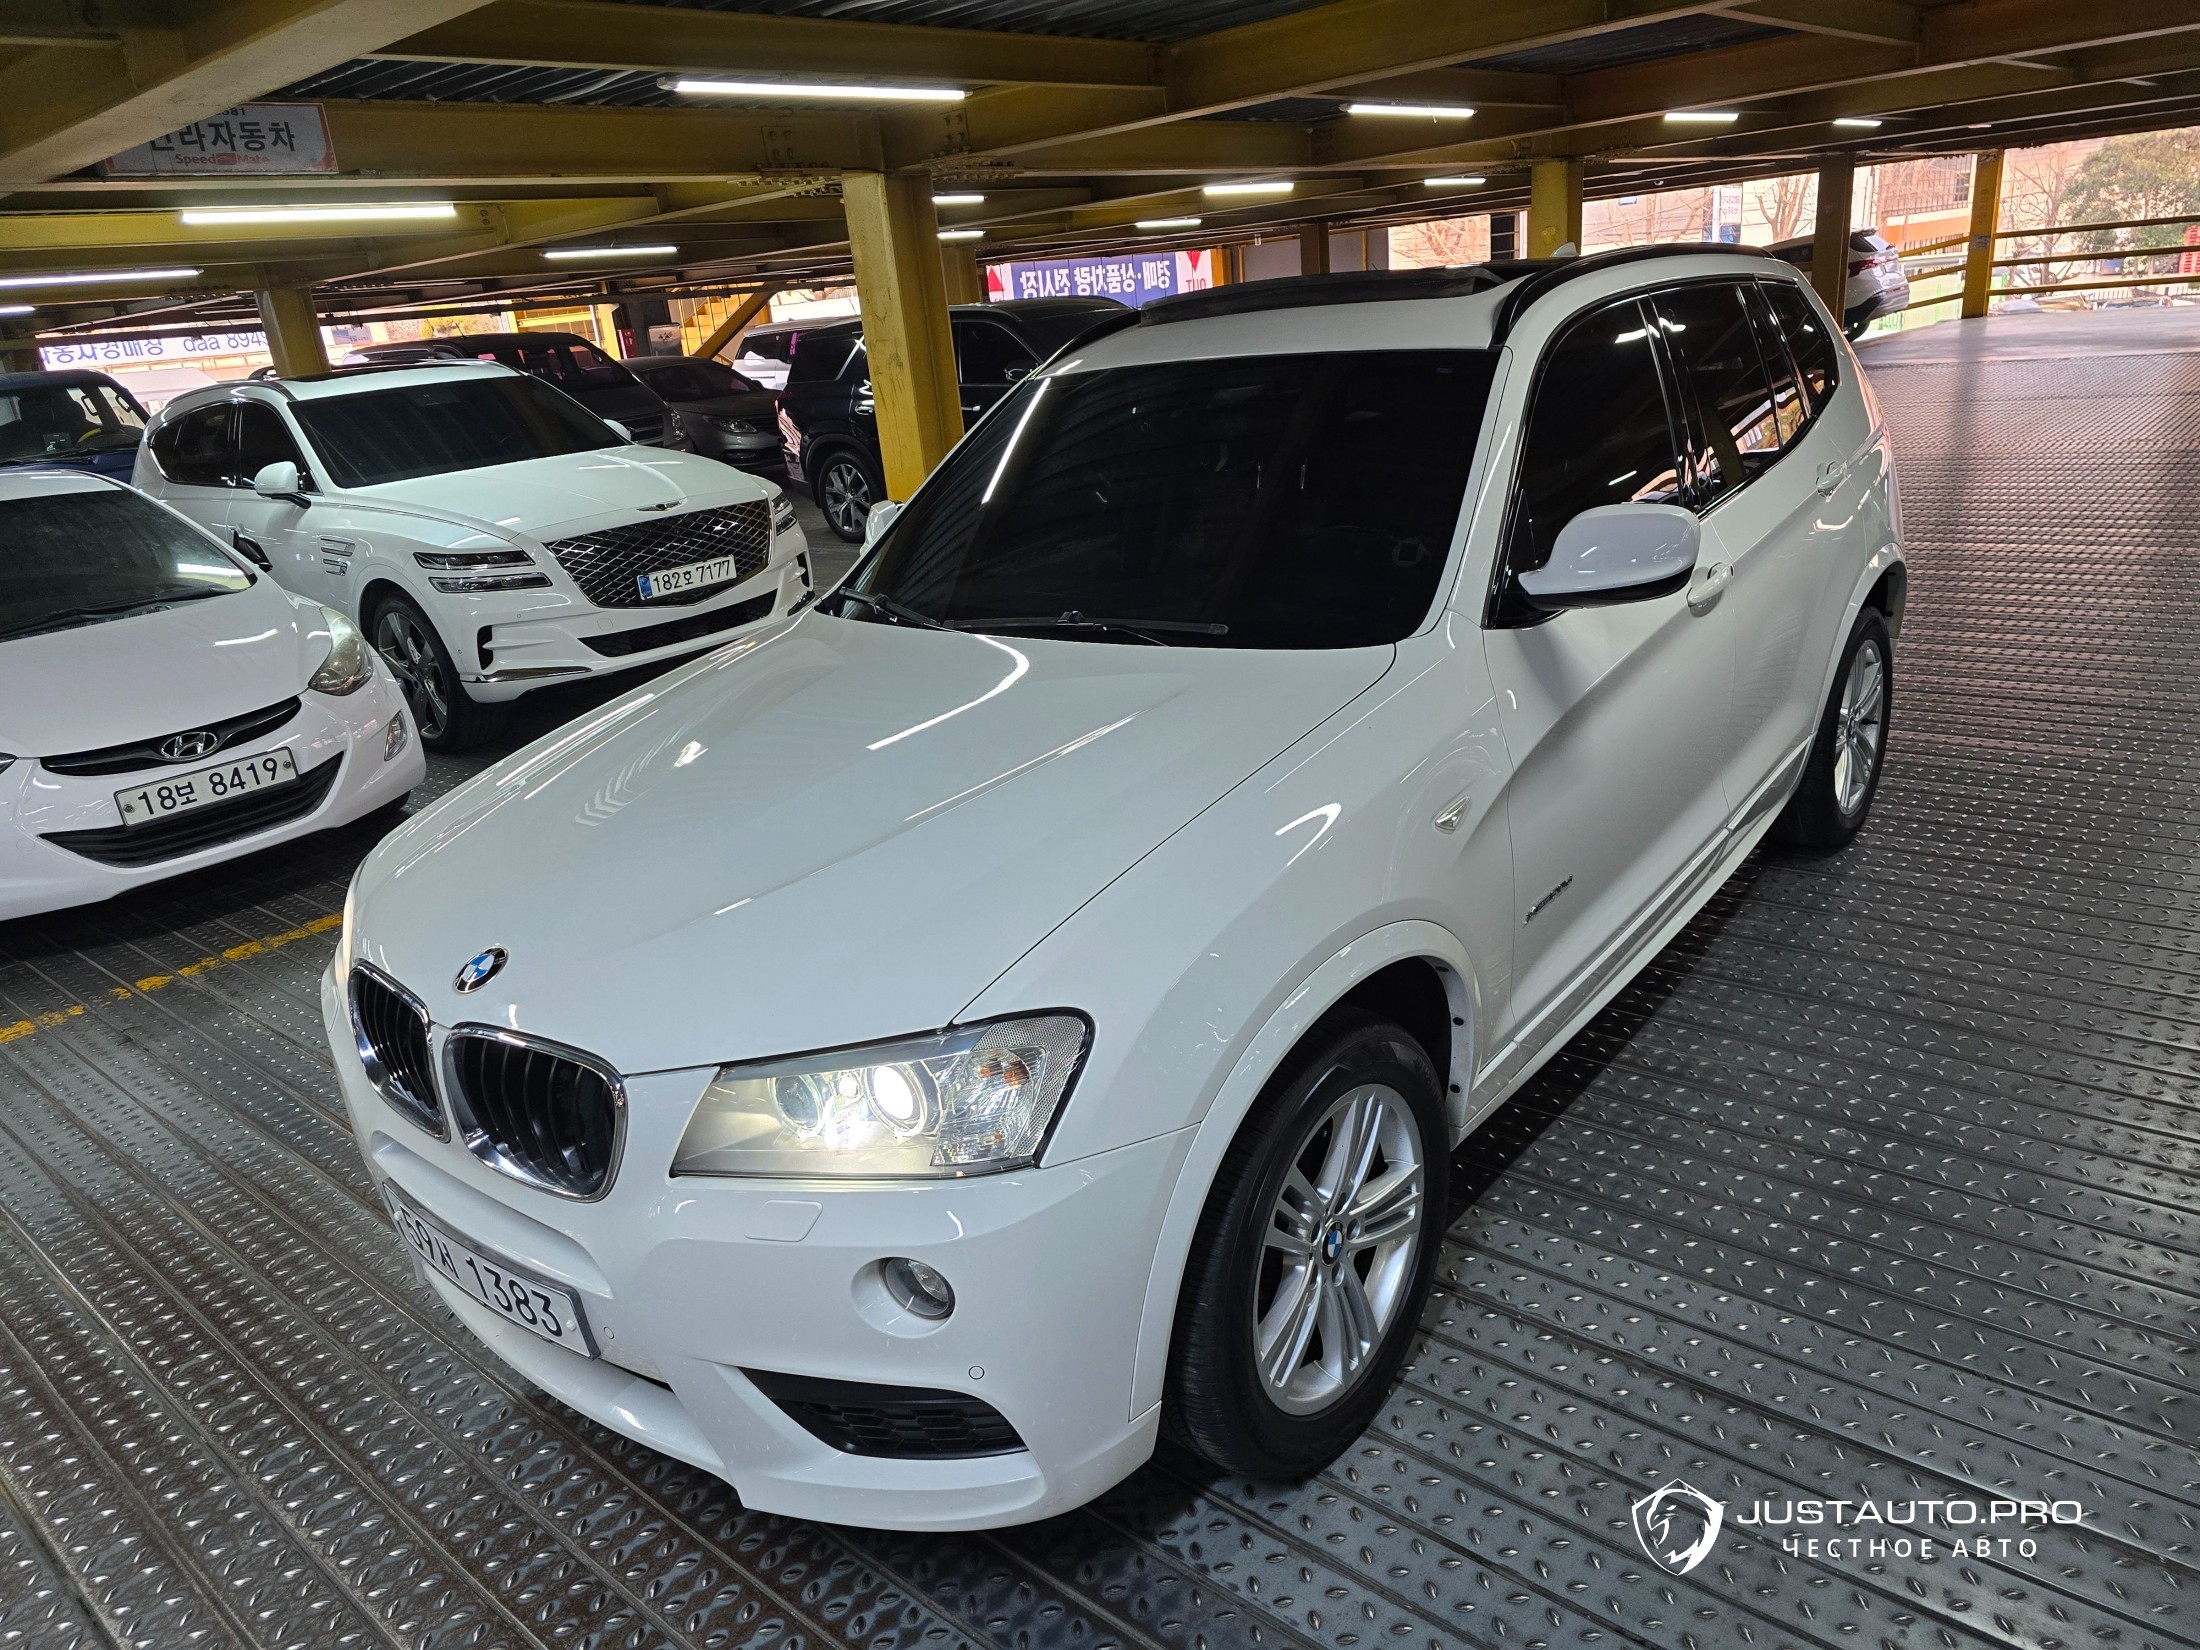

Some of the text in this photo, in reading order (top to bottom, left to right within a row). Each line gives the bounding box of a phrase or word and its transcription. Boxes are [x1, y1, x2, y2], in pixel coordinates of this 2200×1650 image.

[175, 154, 216, 166] Speed
[653, 560, 730, 593] 182호 7177
[138, 757, 277, 815] 18보 8419
[465, 1256, 563, 1337] 1383
